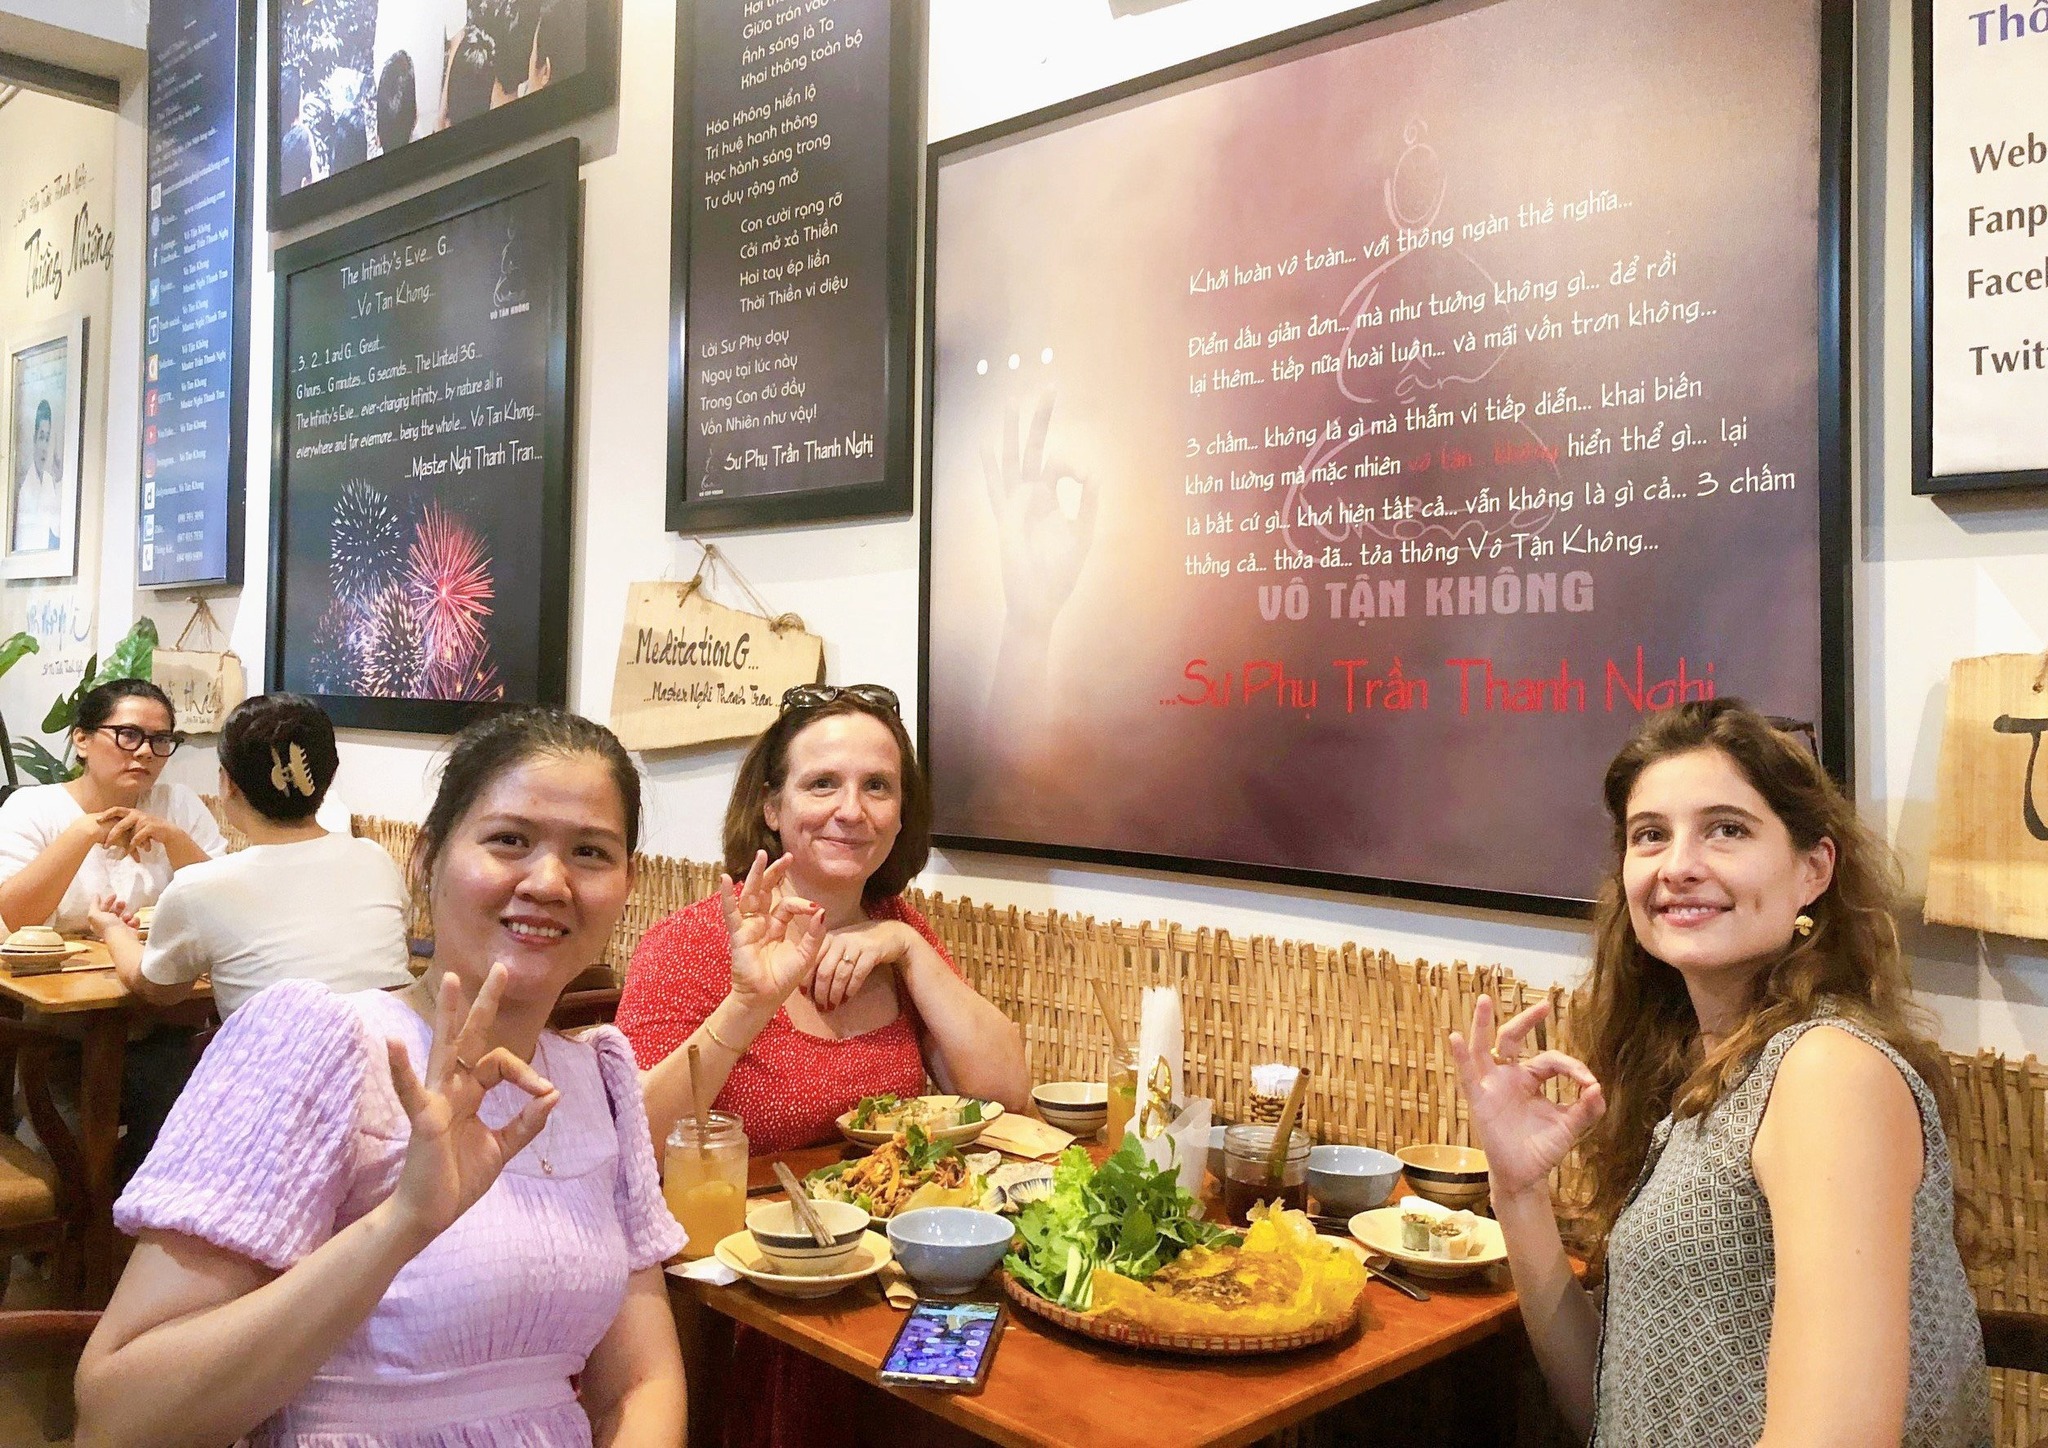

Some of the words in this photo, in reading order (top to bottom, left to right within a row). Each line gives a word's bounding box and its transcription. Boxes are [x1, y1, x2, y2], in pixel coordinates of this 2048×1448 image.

[1190, 268, 1229, 295] Khởi
[1235, 262, 1271, 285] hoàn
[1277, 255, 1298, 277] vô
[1305, 247, 1356, 270] toàn...
[1363, 235, 1389, 258] với
[1397, 227, 1454, 253] thông
[1463, 214, 1508, 246] ngàn
[1518, 197, 1553, 228] thế
[1564, 190, 1633, 221] nghĩa...
[1968, 256, 2048, 300] Face
[376, 292, 393, 312] Tan
[1188, 332, 1228, 358] Điểm
[1234, 324, 1261, 351] dấu
[1268, 322, 1301, 348] giản
[1307, 314, 1350, 336] đơn...
[1357, 306, 1382, 328] mà
[1390, 299, 1421, 322] như
[1429, 290, 1485, 314] tưởng
[1495, 280, 1557, 305] không
[1568, 270, 1599, 298] gì...
[1610, 255, 1639, 285] để
[1647, 250, 1676, 280] rồi
[1190, 375, 1206, 397] lại
[1212, 367, 1264, 389] thêm...
[1271, 359, 1304, 382] tiếp
[1311, 354, 1341, 375] nữa
[1348, 345, 1383, 367] hoài
[1391, 338, 1445, 362] luôn...
[1454, 332, 1476, 353] và
[1484, 323, 1517, 348] mãi
[1525, 314, 1561, 340] vốn
[1572, 311, 1619, 336] trơn
[1629, 300, 1717, 327] không...
[1186, 438, 1200, 458] 3
[1206, 431, 1258, 455] chấm...
[1265, 426, 1316, 448] không
[1326, 419, 1341, 441] là
[1348, 418, 1364, 437] gì
[1371, 413, 1397, 435] mà
[1461, 402, 1477, 424] vi
[1485, 394, 1526, 422] tiếp
[1535, 387, 1592, 415] diễn...
[1601, 381, 1645, 408] khai
[1655, 372, 1702, 401] biến
[1185, 474, 1223, 495] khôn
[1230, 470, 1274, 491] lường
[1281, 465, 1305, 485] mà
[1312, 464, 1347, 487] mặc
[1355, 456, 1401, 479] nhiên
[1568, 429, 1611, 457] hiển
[1621, 421, 1664, 452] thể
[1672, 423, 1707, 452] gì...
[1721, 417, 1747, 447] lại
[1186, 517, 1200, 536] là
[1206, 512, 1233, 534] bất
[1240, 513, 1260, 530] cứ
[1265, 510, 1290, 533] gì...
[1339, 502, 1374, 526] hiện
[1382, 495, 1414, 520] tất
[1422, 496, 1457, 517] cả...
[1465, 487, 1499, 514] vẫn
[1508, 486, 1573, 512] không
[1585, 482, 1605, 505] là
[1615, 481, 1634, 507] gì
[1643, 477, 1686, 500] cả...
[1697, 472, 1718, 496] 3
[1730, 463, 1796, 494] chấm
[1185, 553, 1230, 577] thống
[1237, 552, 1267, 572] cả...
[1274, 545, 1313, 570] thỏa
[1320, 545, 1352, 568] đã...
[1360, 544, 1393, 565] tỏa
[1400, 541, 1459, 565] thông
[1466, 530, 1502, 559] Vô
[1511, 532, 1553, 561] Tận
[1563, 524, 1659, 555] Không...
[1258, 576, 1309, 621] VÔ
[1325, 574, 1405, 627] TẬN
[1425, 566, 1594, 617] KHÔNG
[1243, 661, 1316, 719] Phụ
[1333, 656, 1428, 713] Trần
[1444, 657, 1585, 715] Thanh
